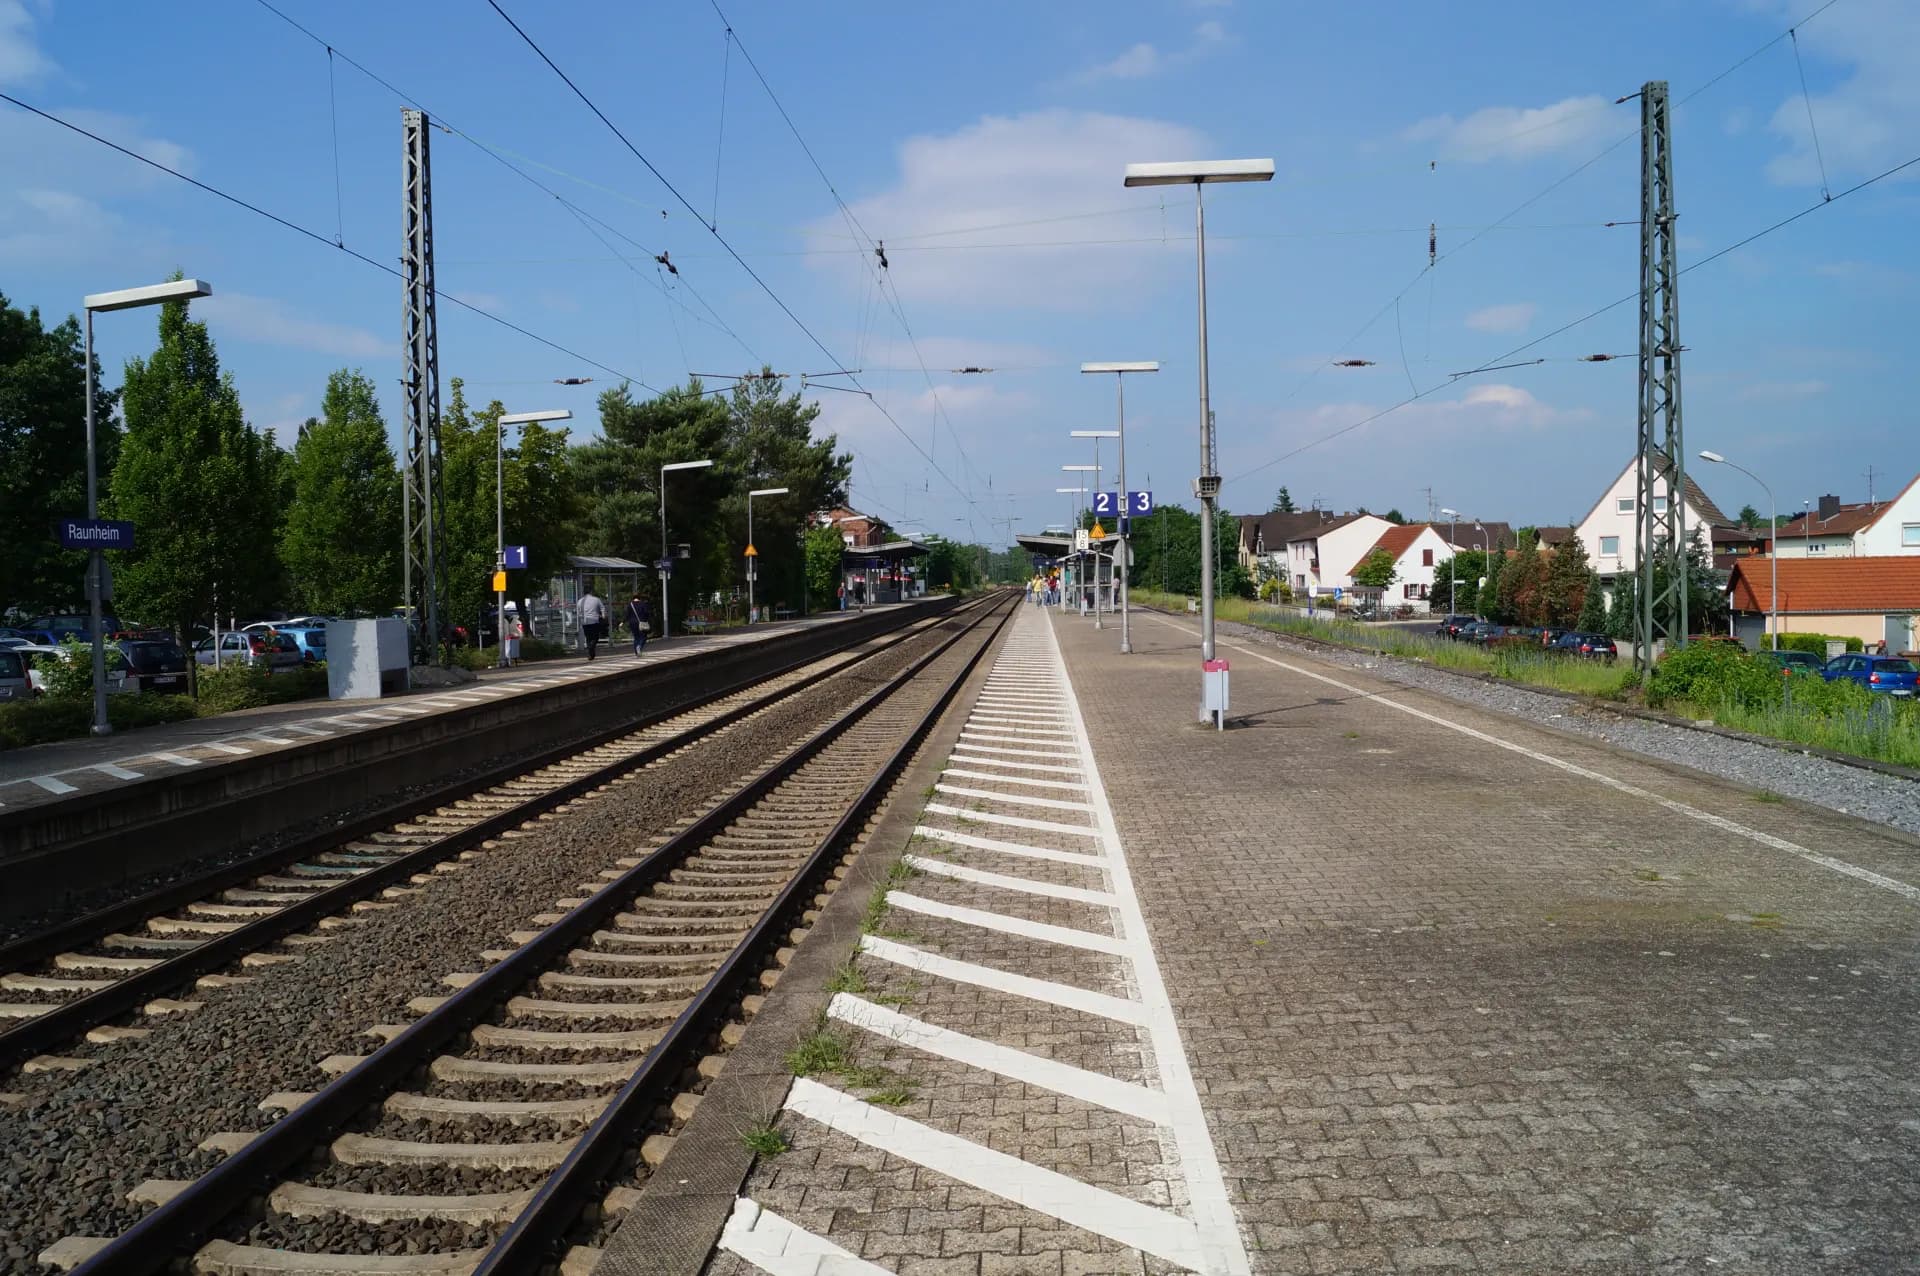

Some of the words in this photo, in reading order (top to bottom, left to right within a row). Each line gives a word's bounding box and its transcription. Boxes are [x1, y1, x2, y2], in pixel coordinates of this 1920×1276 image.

[1097, 493, 1109, 511] 2
[1137, 492, 1149, 511] 3
[68, 523, 120, 540] Raunheim
[1078, 530, 1087, 539] 15
[516, 546, 525, 564] 1
